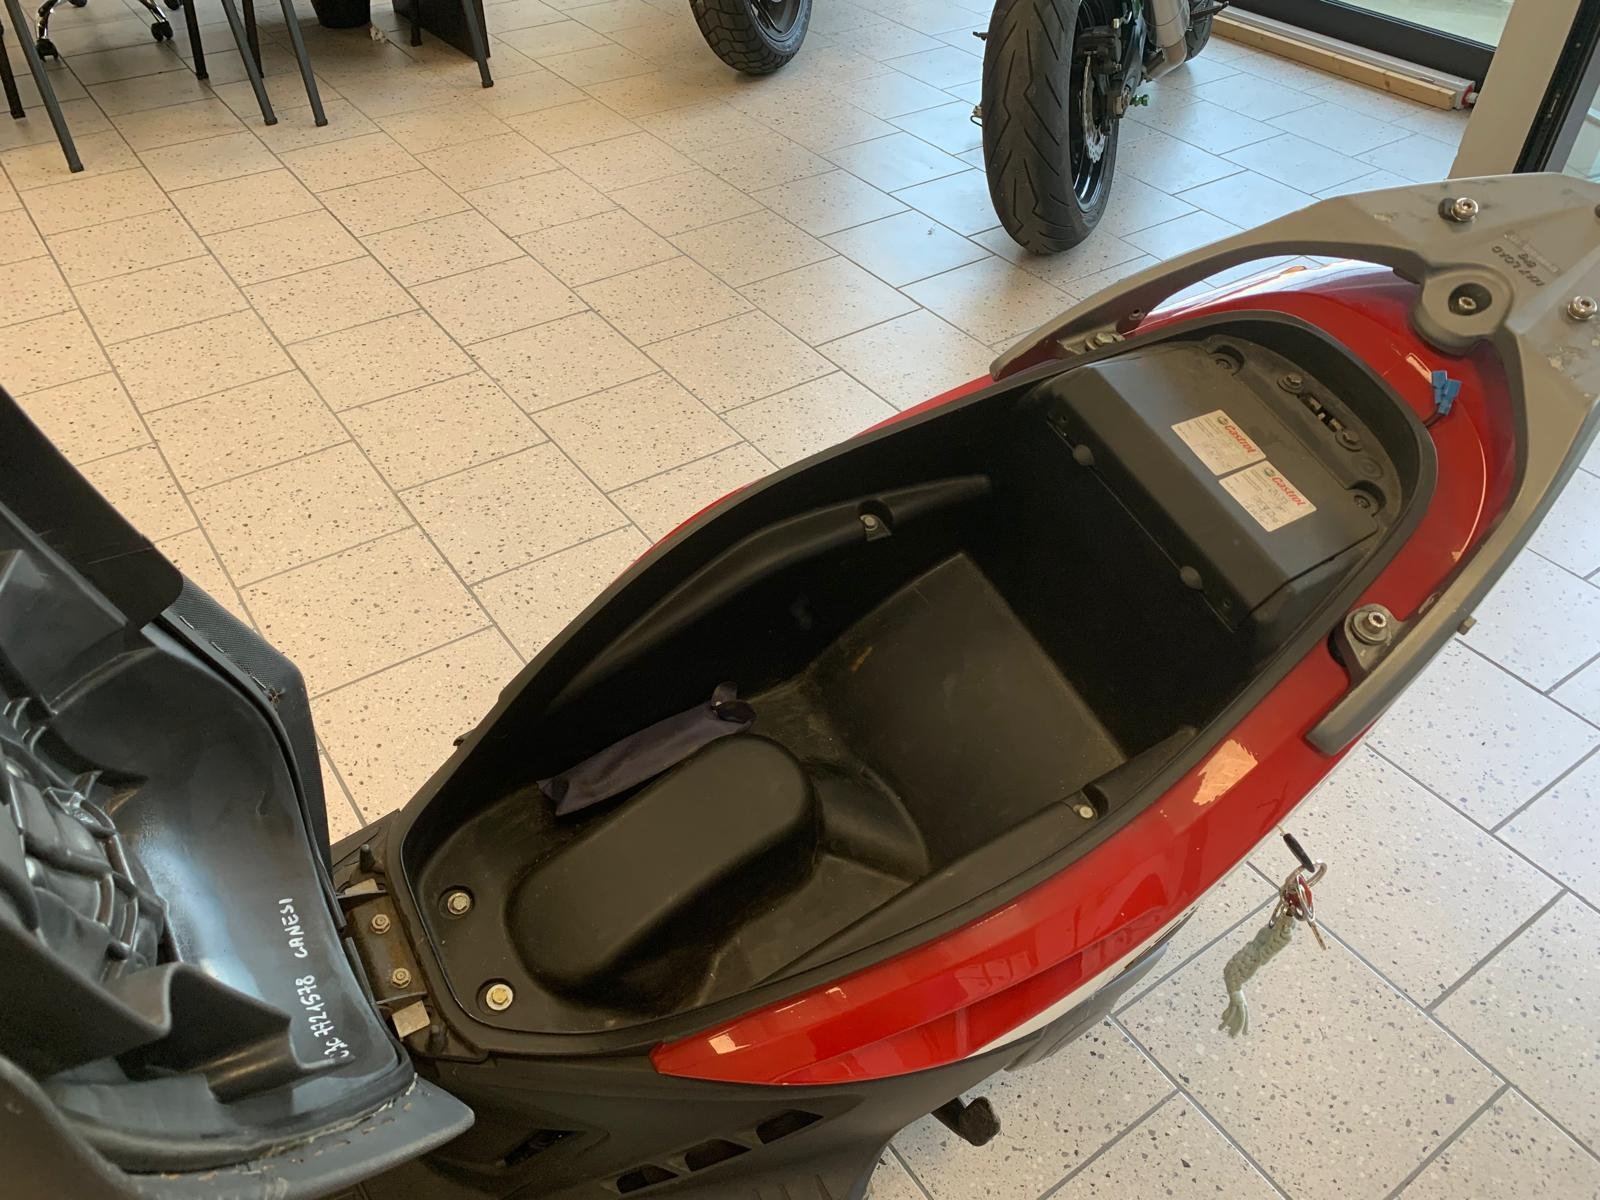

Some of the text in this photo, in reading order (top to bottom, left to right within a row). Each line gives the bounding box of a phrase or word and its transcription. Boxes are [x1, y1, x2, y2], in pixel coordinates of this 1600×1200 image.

[1224, 424, 1256, 454] Castrol
[1272, 476, 1306, 506] Castrol
[295, 974, 334, 1038] 7721578
